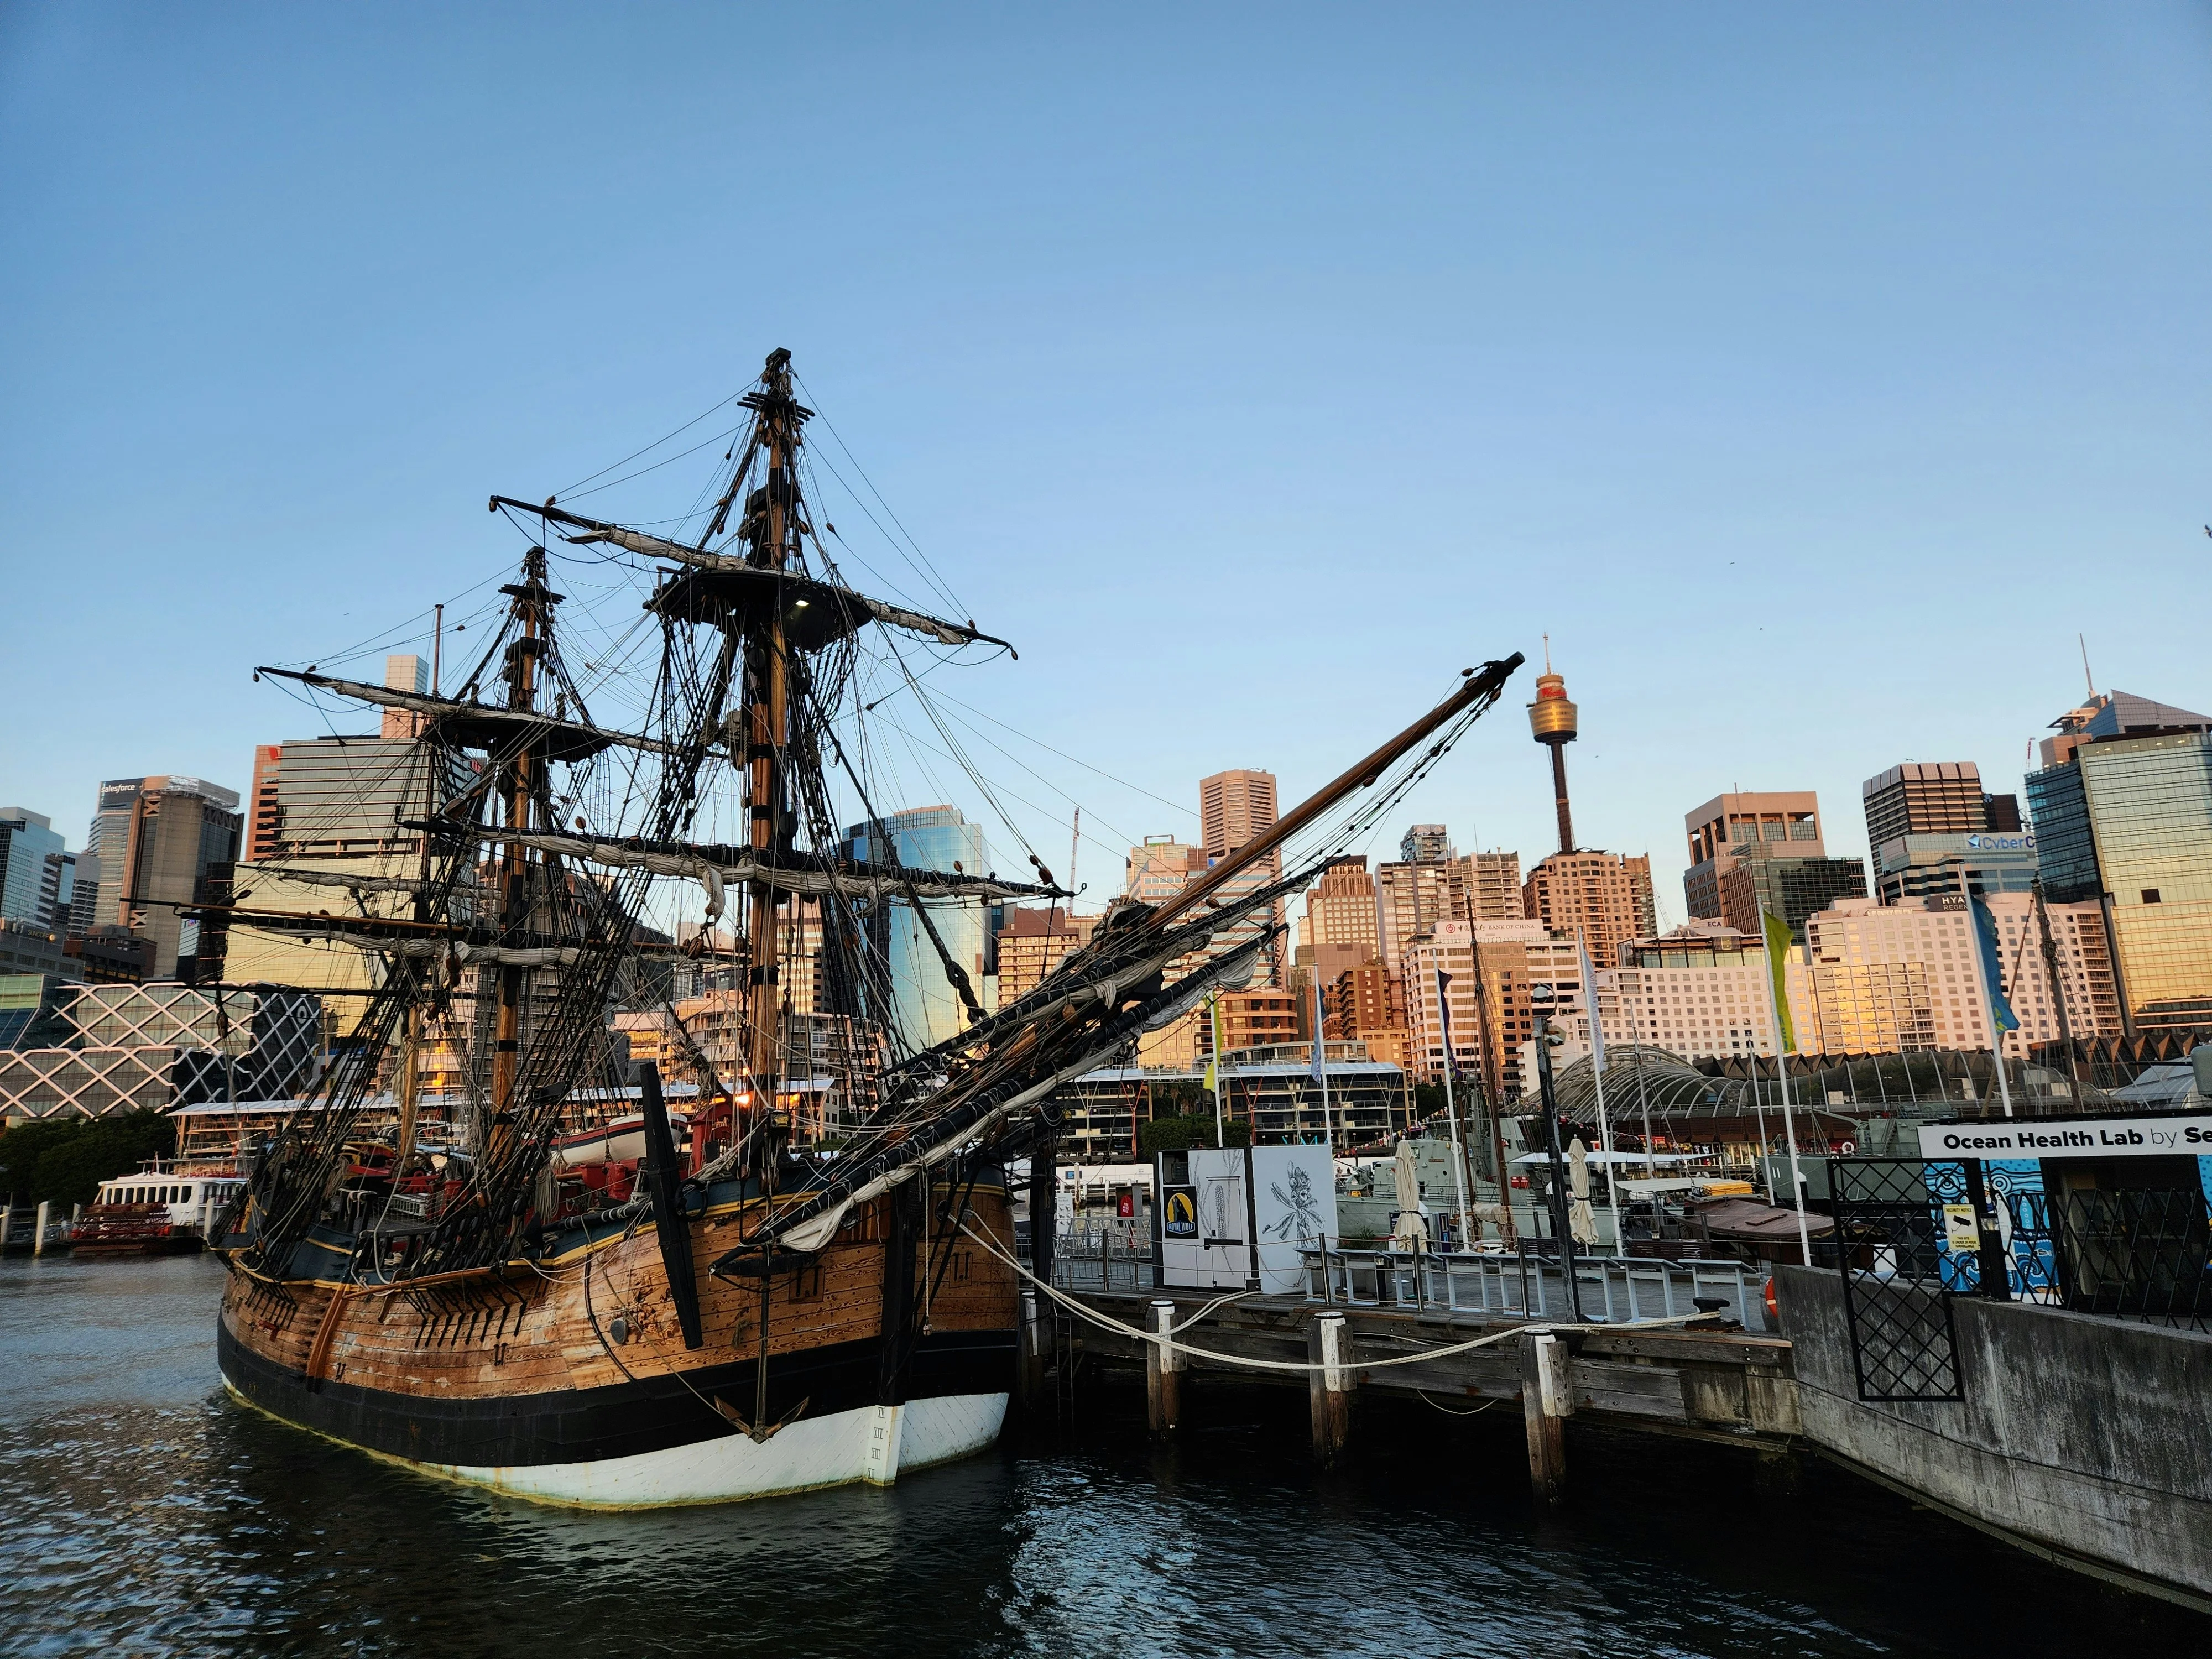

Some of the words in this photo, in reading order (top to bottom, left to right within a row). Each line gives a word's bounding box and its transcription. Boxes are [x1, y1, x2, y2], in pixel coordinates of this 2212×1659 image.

[101, 784, 135, 794] salesforce
[1943, 1134, 2012, 1149] Ocean
[2017, 1130, 2094, 1149] Health
[2101, 1129, 2143, 1145] Lab
[2150, 1128, 2177, 1149] by
[2184, 1126, 2212, 1143] Se
[1772, 1167, 1781, 1178] 11
[1168, 1222, 1181, 1232] ROYAL
[1181, 1222, 1193, 1232] WOLF
